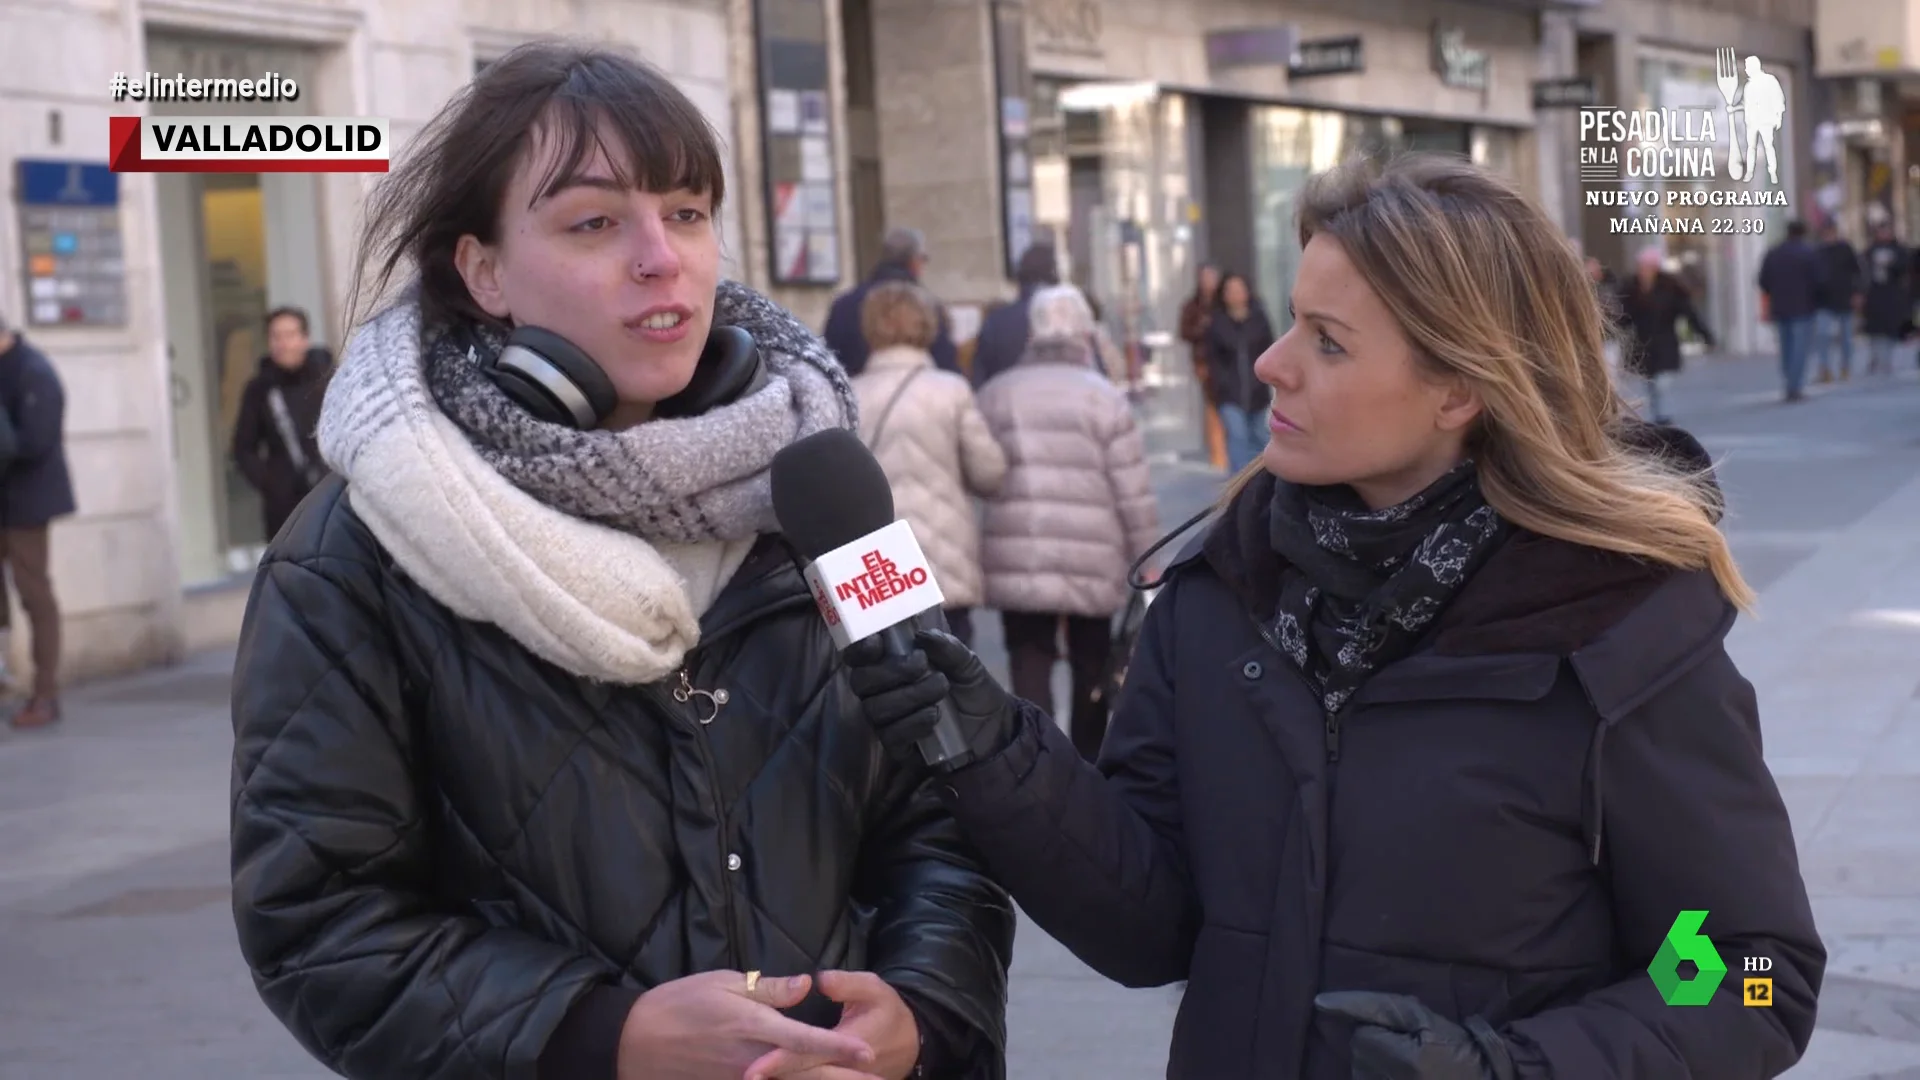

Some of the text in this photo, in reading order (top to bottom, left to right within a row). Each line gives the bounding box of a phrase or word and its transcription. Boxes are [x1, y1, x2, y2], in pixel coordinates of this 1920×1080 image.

[861, 549, 889, 571] EL
[835, 561, 900, 602] INTER
[856, 567, 928, 610] MEDIO
